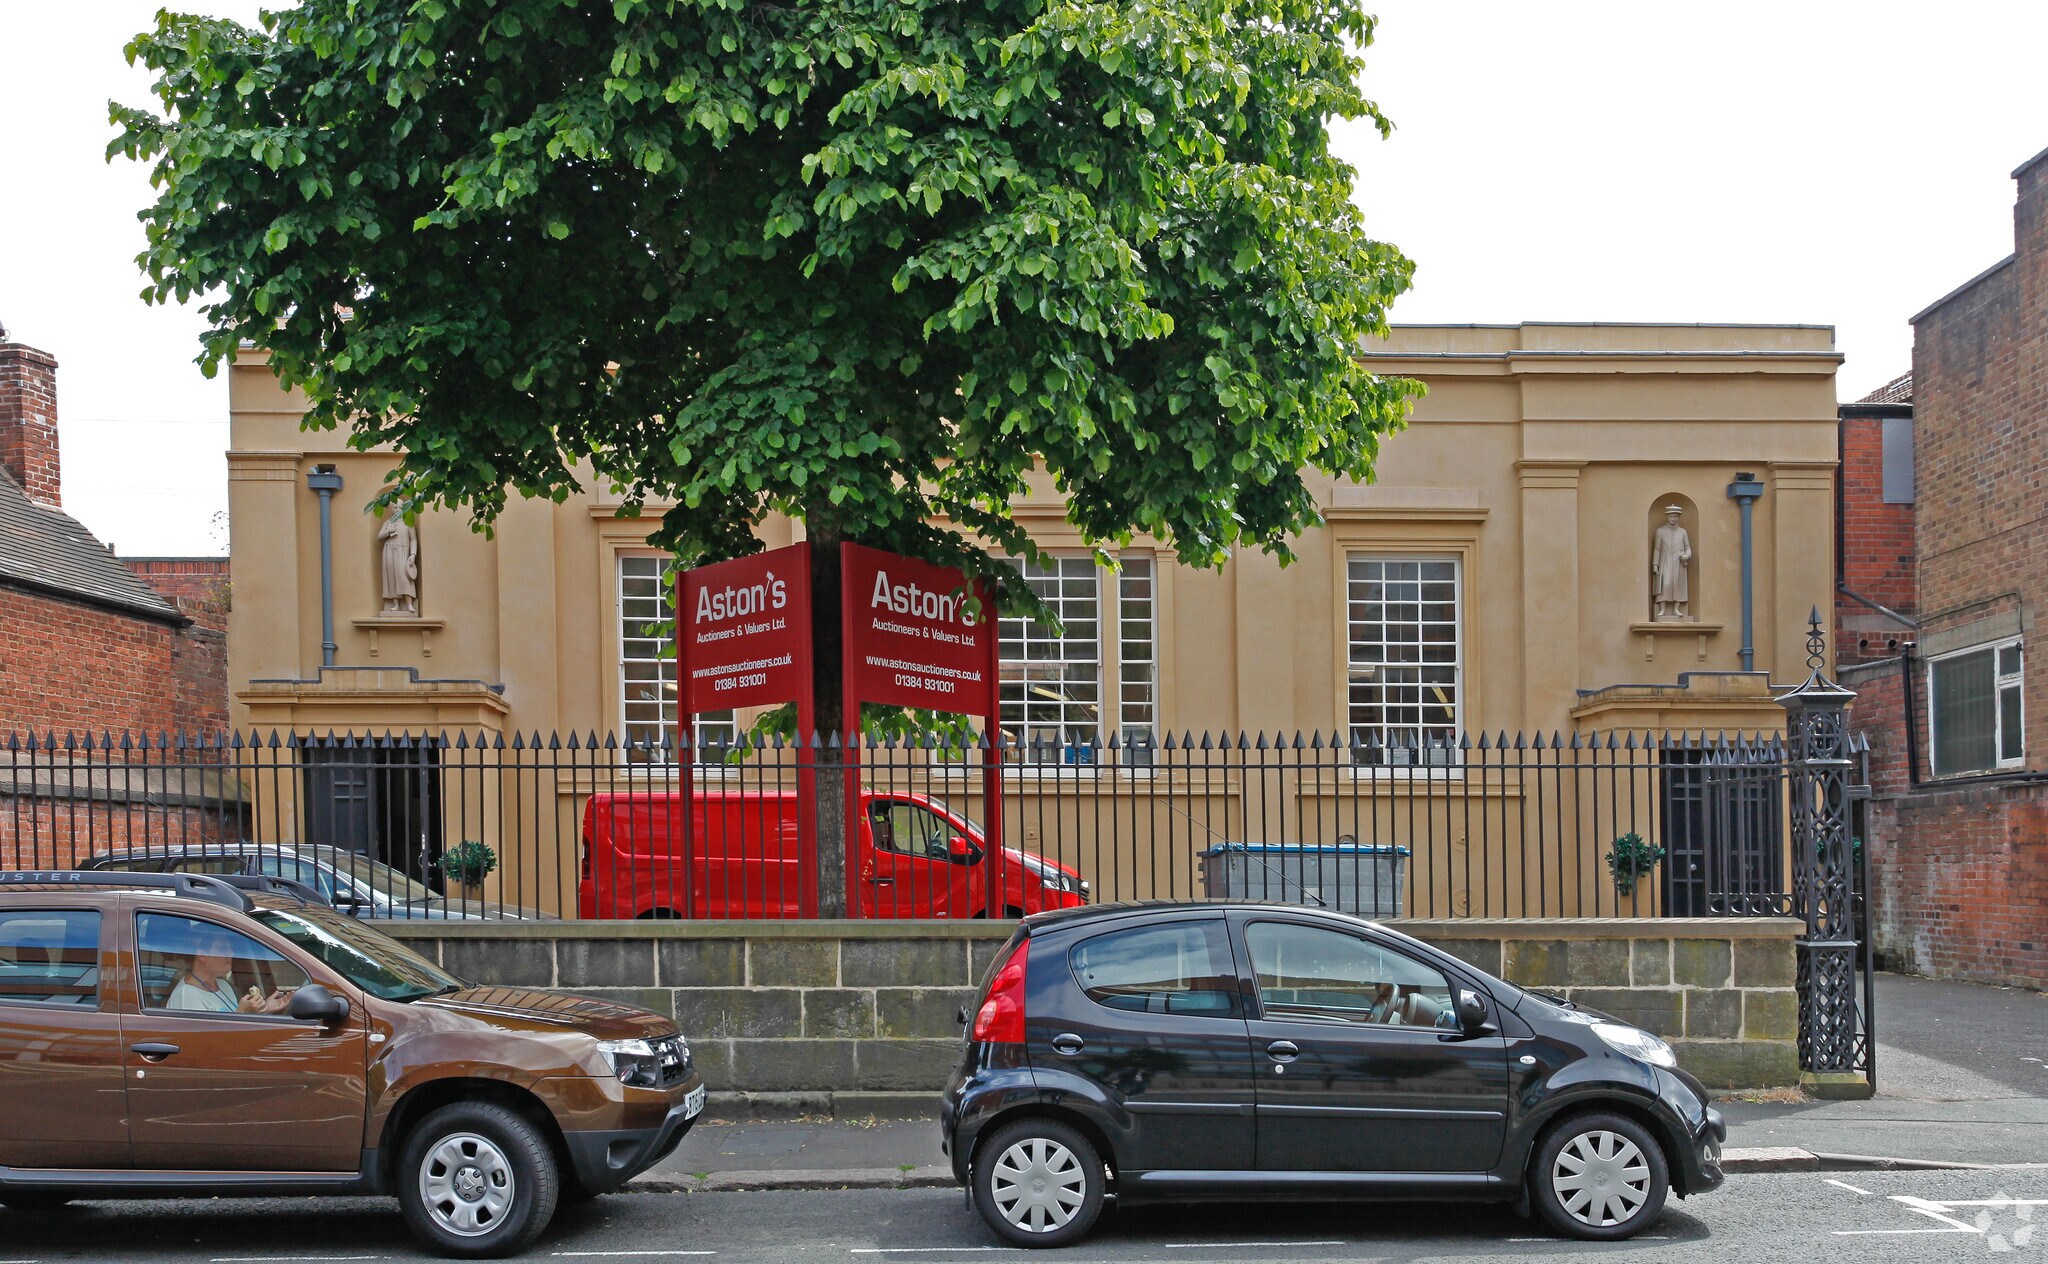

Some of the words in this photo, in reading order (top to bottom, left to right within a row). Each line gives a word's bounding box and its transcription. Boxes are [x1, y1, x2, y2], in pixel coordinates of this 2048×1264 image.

[695, 571, 787, 625] Aston's
[696, 628, 736, 644] Auctioneers
[737, 625, 743, 636] &
[744, 620, 771, 635] Valuers
[772, 617, 786, 631] Ltd.
[872, 618, 921, 637] Auctioneers
[923, 627, 929, 638] &
[931, 628, 960, 645] Valuers
[961, 634, 976, 647] Ltd.
[692, 653, 793, 679] www.astonsauctioneers.co.uk
[866, 655, 982, 682] www.astonsauctioneers.co.uk
[714, 677, 737, 691] 01384
[739, 673, 767, 688] 931001
[895, 674, 922, 689] 01384
[924, 677, 955, 693] 931001
